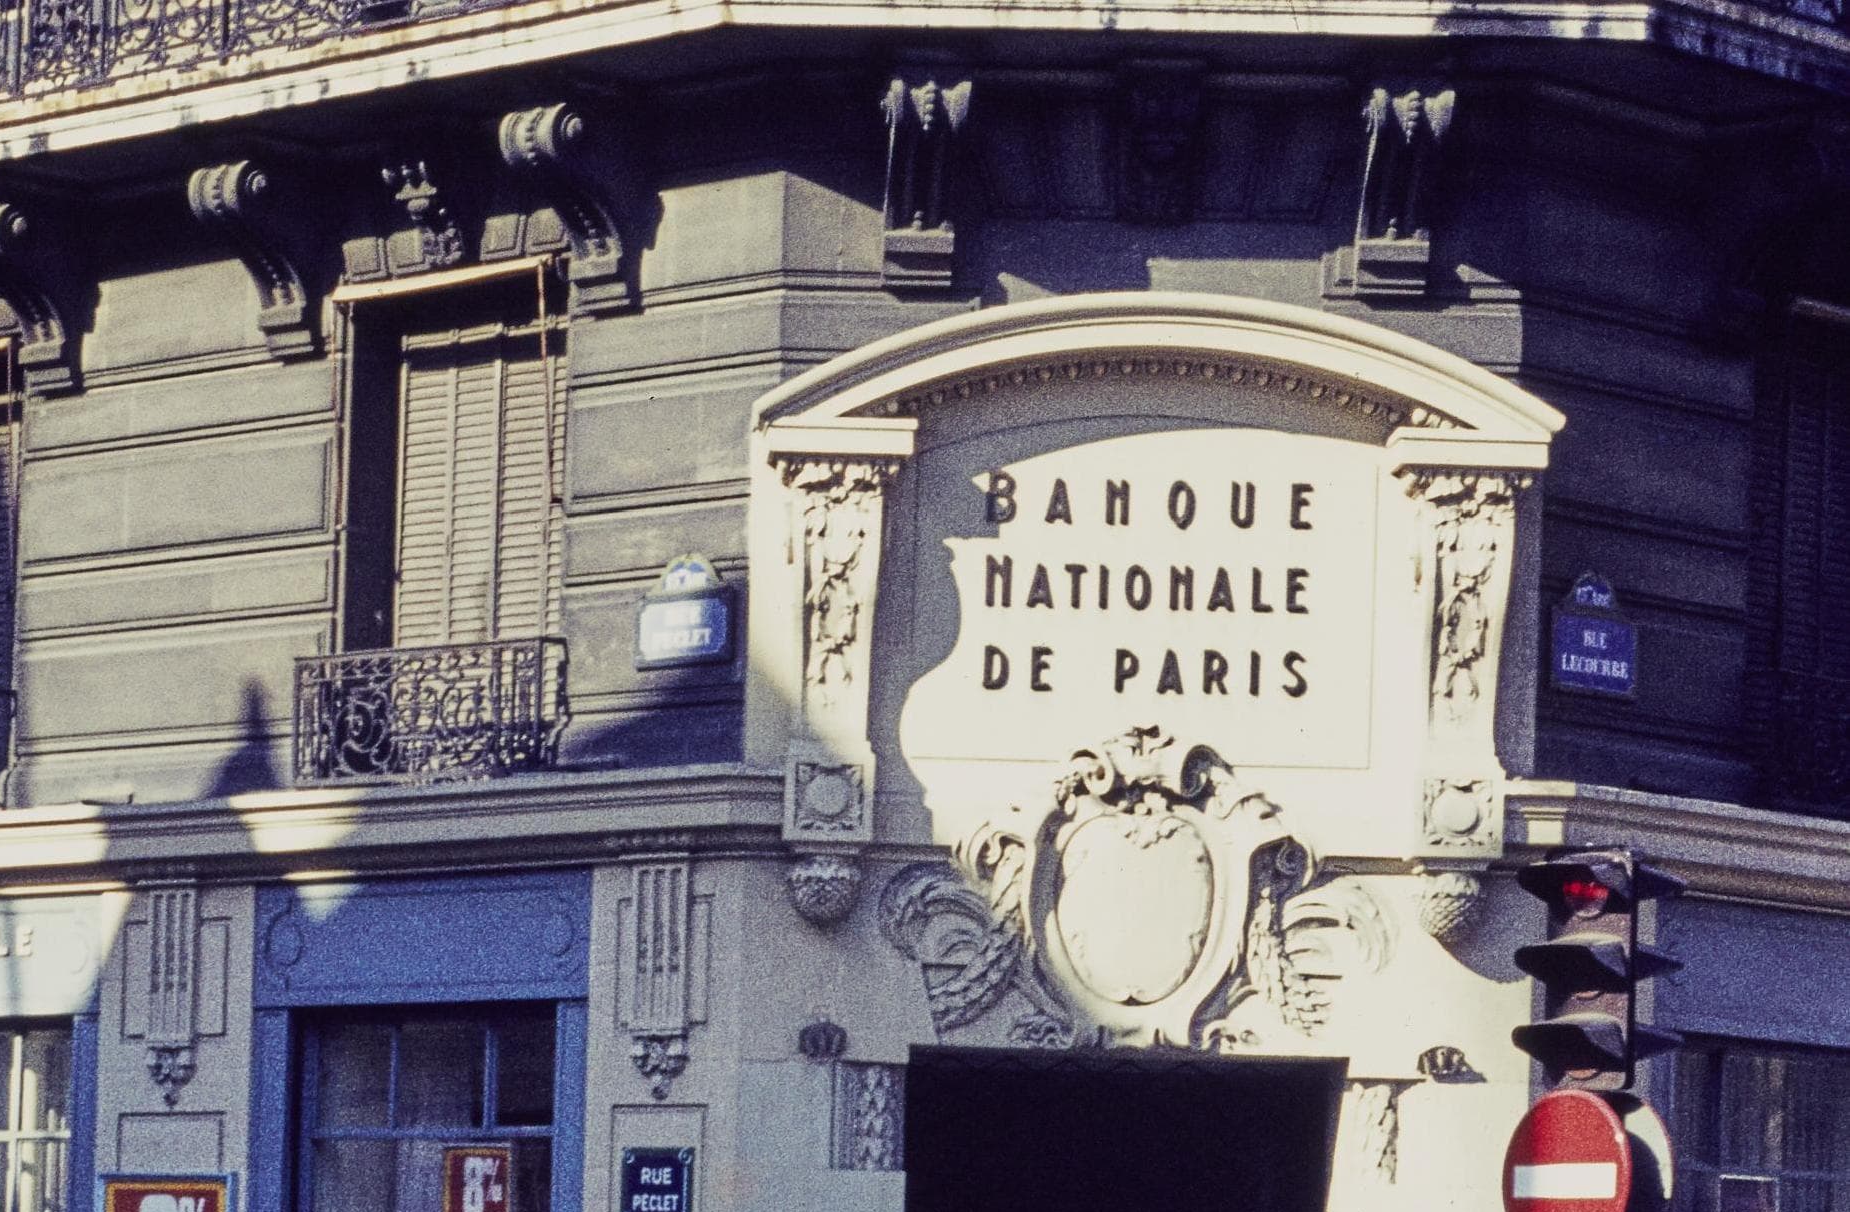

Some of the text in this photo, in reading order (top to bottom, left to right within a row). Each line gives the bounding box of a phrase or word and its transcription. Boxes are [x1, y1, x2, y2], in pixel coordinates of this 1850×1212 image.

[985, 472, 1314, 531] BANQUE
[984, 556, 1312, 615] NATIONALE
[981, 643, 1310, 699] DE PARIS
[1561, 653, 1628, 679] LECOURBE
[640, 1166, 672, 1186] RUE
[632, 1193, 679, 1212] PECLET
